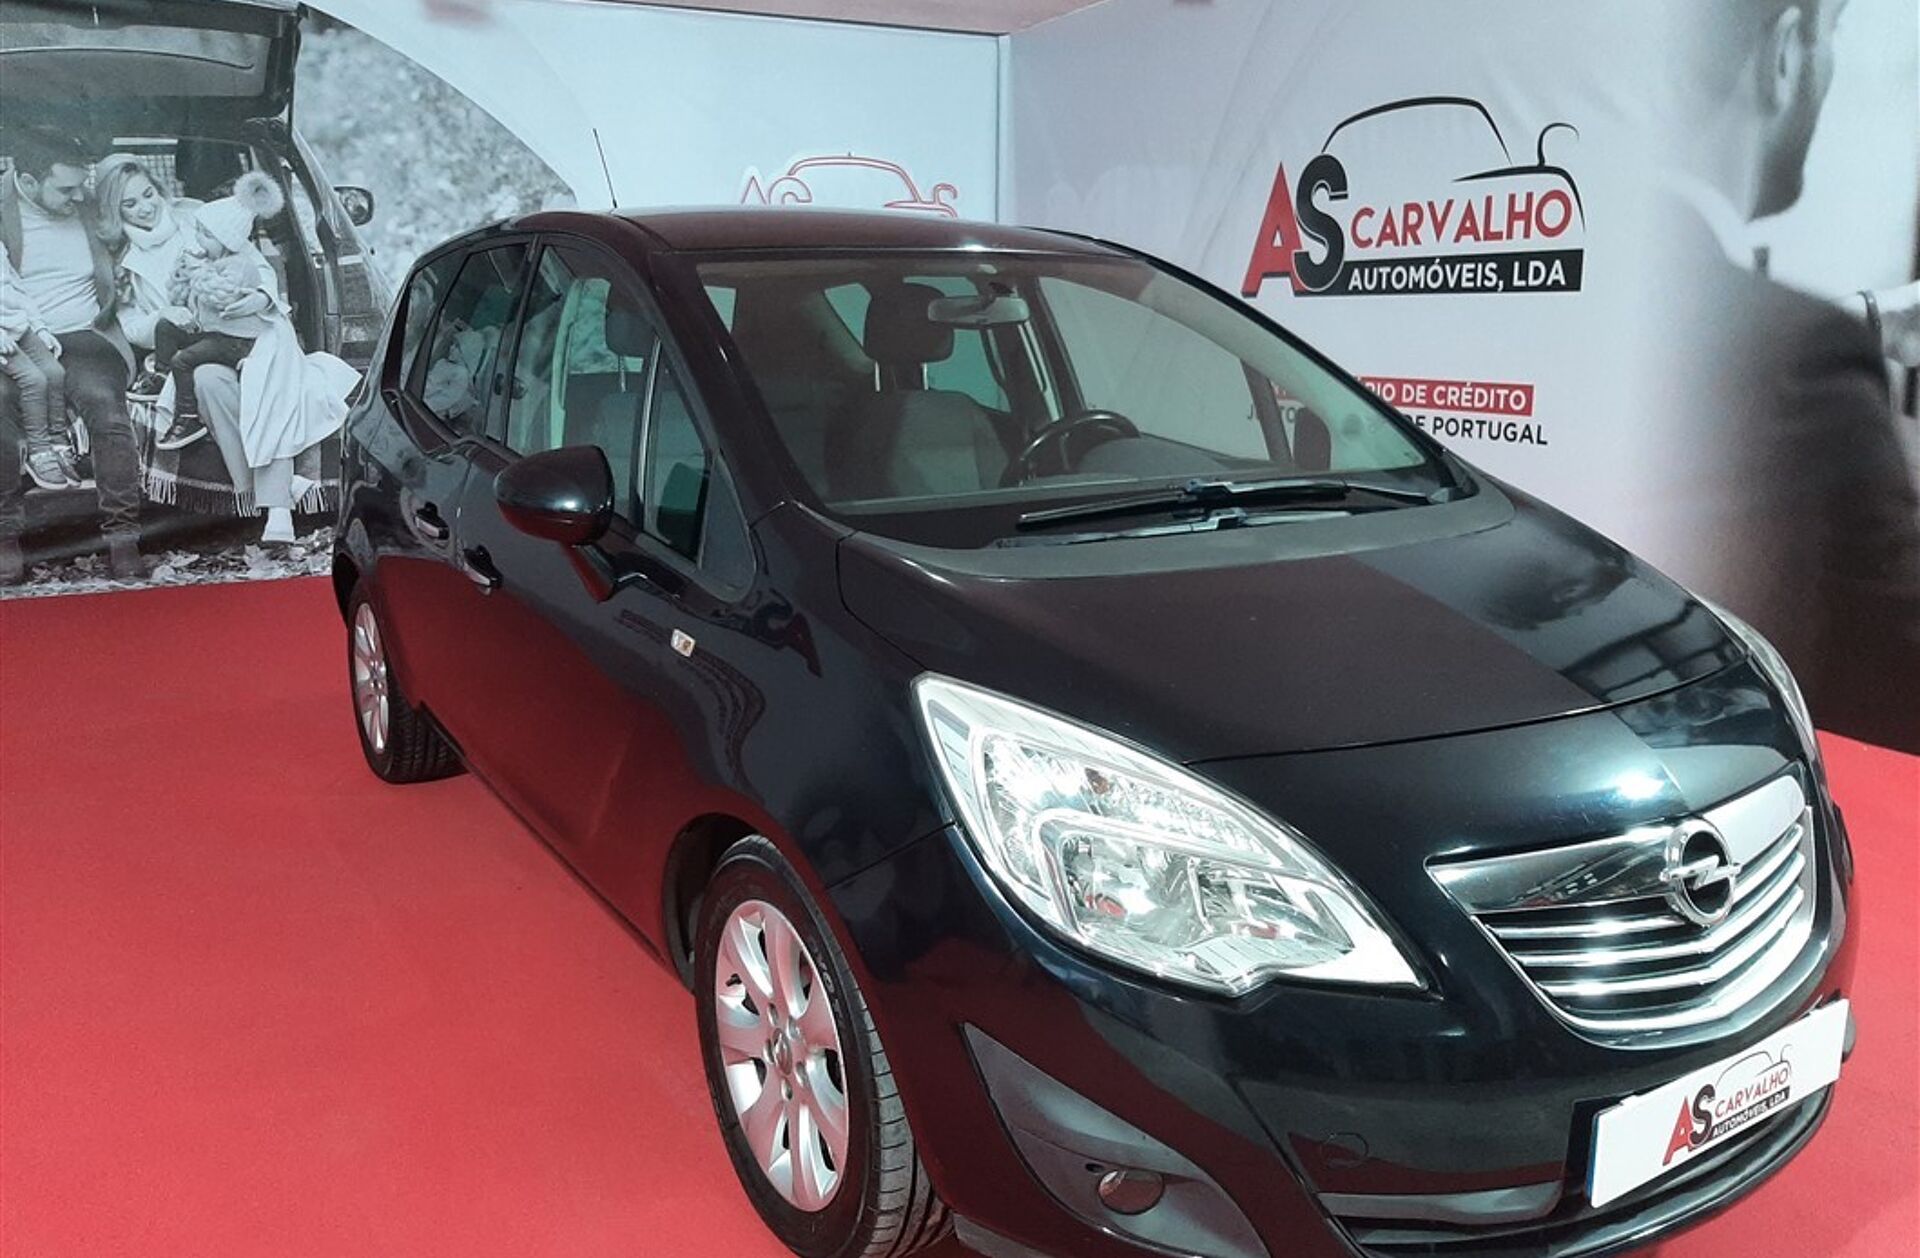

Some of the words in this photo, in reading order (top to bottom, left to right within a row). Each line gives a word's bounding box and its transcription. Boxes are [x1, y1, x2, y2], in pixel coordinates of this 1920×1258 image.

[1241, 153, 1349, 298] AS
[1350, 189, 1572, 249] CARVALHO
[1348, 258, 1504, 292] AUTOMÓVEIS,
[1512, 259, 1567, 287] LDA
[1402, 383, 1427, 404] DE
[1433, 381, 1526, 411] CRÉDITO
[1432, 416, 1548, 446] PORTUGAL
[1662, 1083, 1716, 1166] AS
[1714, 1067, 1789, 1118] CARVALHO
